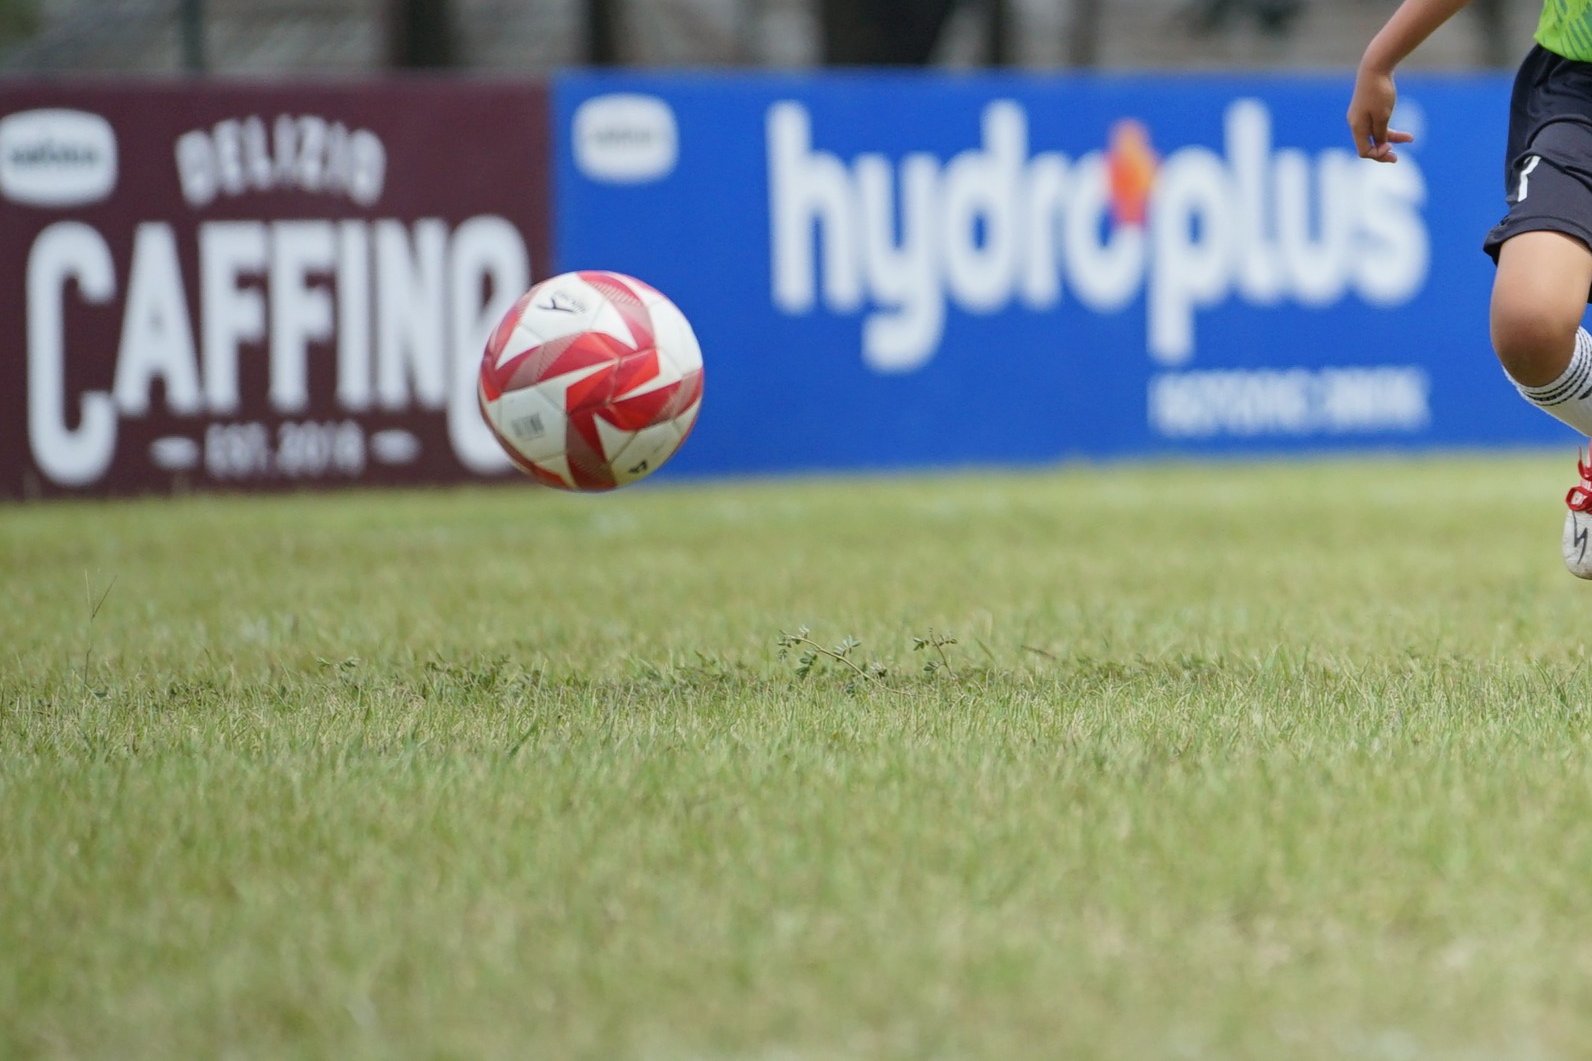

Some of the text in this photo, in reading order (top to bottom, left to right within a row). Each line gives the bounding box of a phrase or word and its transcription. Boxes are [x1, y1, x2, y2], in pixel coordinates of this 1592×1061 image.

[175, 112, 387, 208] DELIZIO
[765, 98, 1431, 374] hydroplus
[26, 214, 531, 487] CAFFINO
